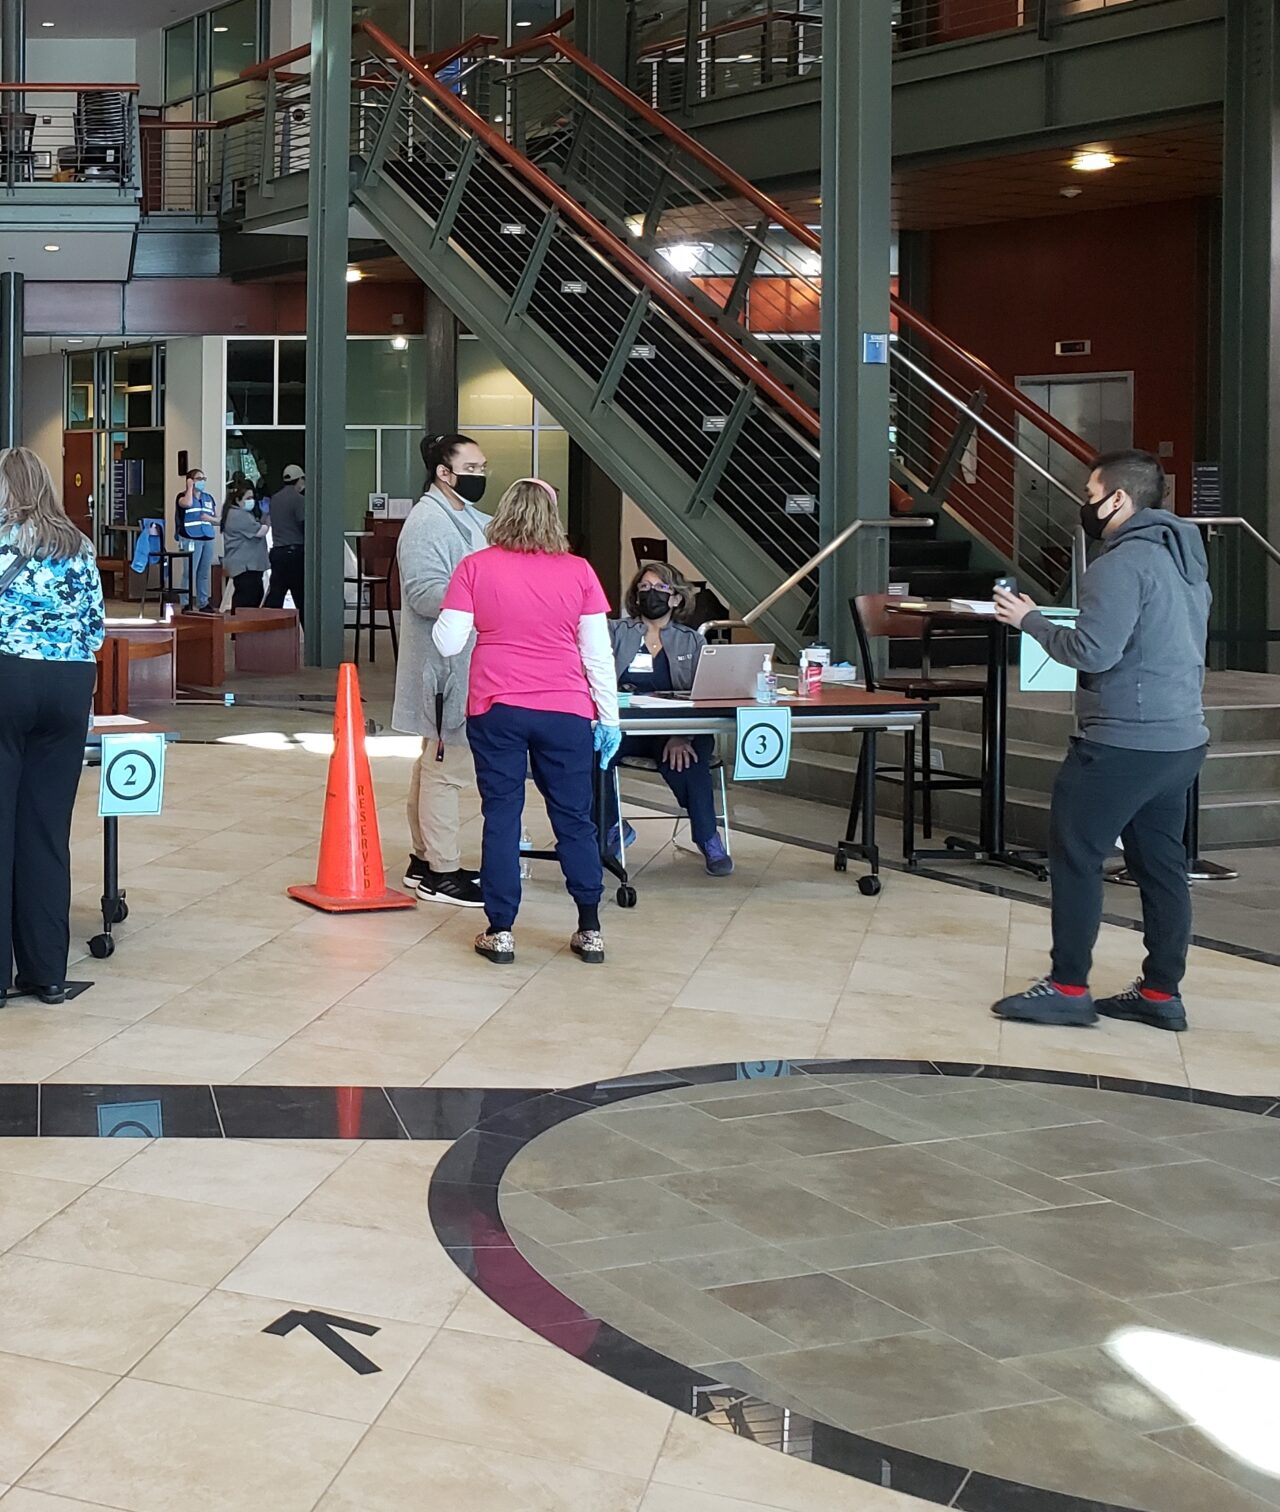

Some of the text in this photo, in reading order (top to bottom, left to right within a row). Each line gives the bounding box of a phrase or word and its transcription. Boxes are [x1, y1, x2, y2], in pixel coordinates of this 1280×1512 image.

[754, 734, 767, 755] 3
[123, 763, 137, 786] 2
[356, 784, 371, 890] RESERVED
